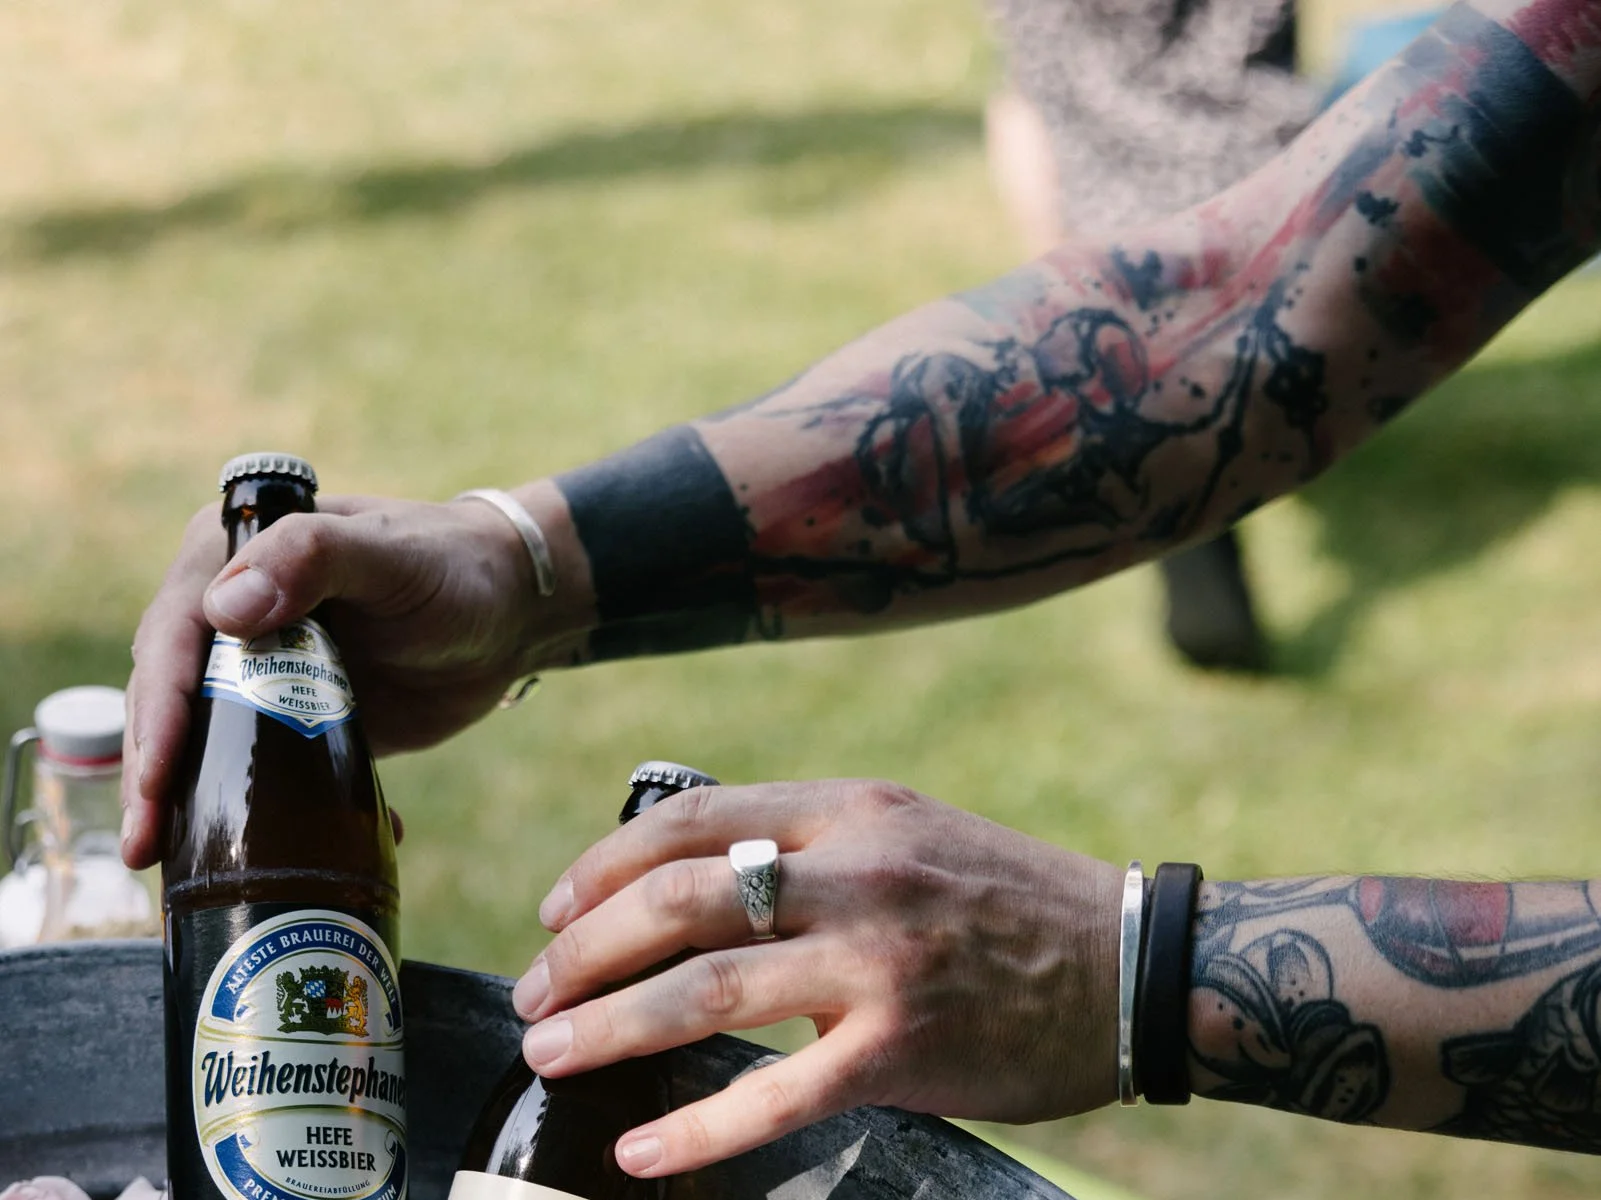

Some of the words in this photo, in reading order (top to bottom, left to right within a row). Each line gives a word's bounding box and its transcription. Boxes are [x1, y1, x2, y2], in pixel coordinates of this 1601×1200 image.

[291, 684, 318, 698] HEFE
[279, 695, 330, 712] WEISSBIER
[225, 941, 277, 995] ÄLTESTE
[279, 929, 355, 949] BRAUEREI
[358, 942, 380, 969] DER
[380, 967, 397, 1005] WELT
[201, 1050, 406, 1110] Weihenstephane
[306, 1126, 353, 1146] HEFE
[276, 1150, 377, 1172] WEISSBIER
[285, 1176, 371, 1195] BRAUEREIABFÜLLUNG
